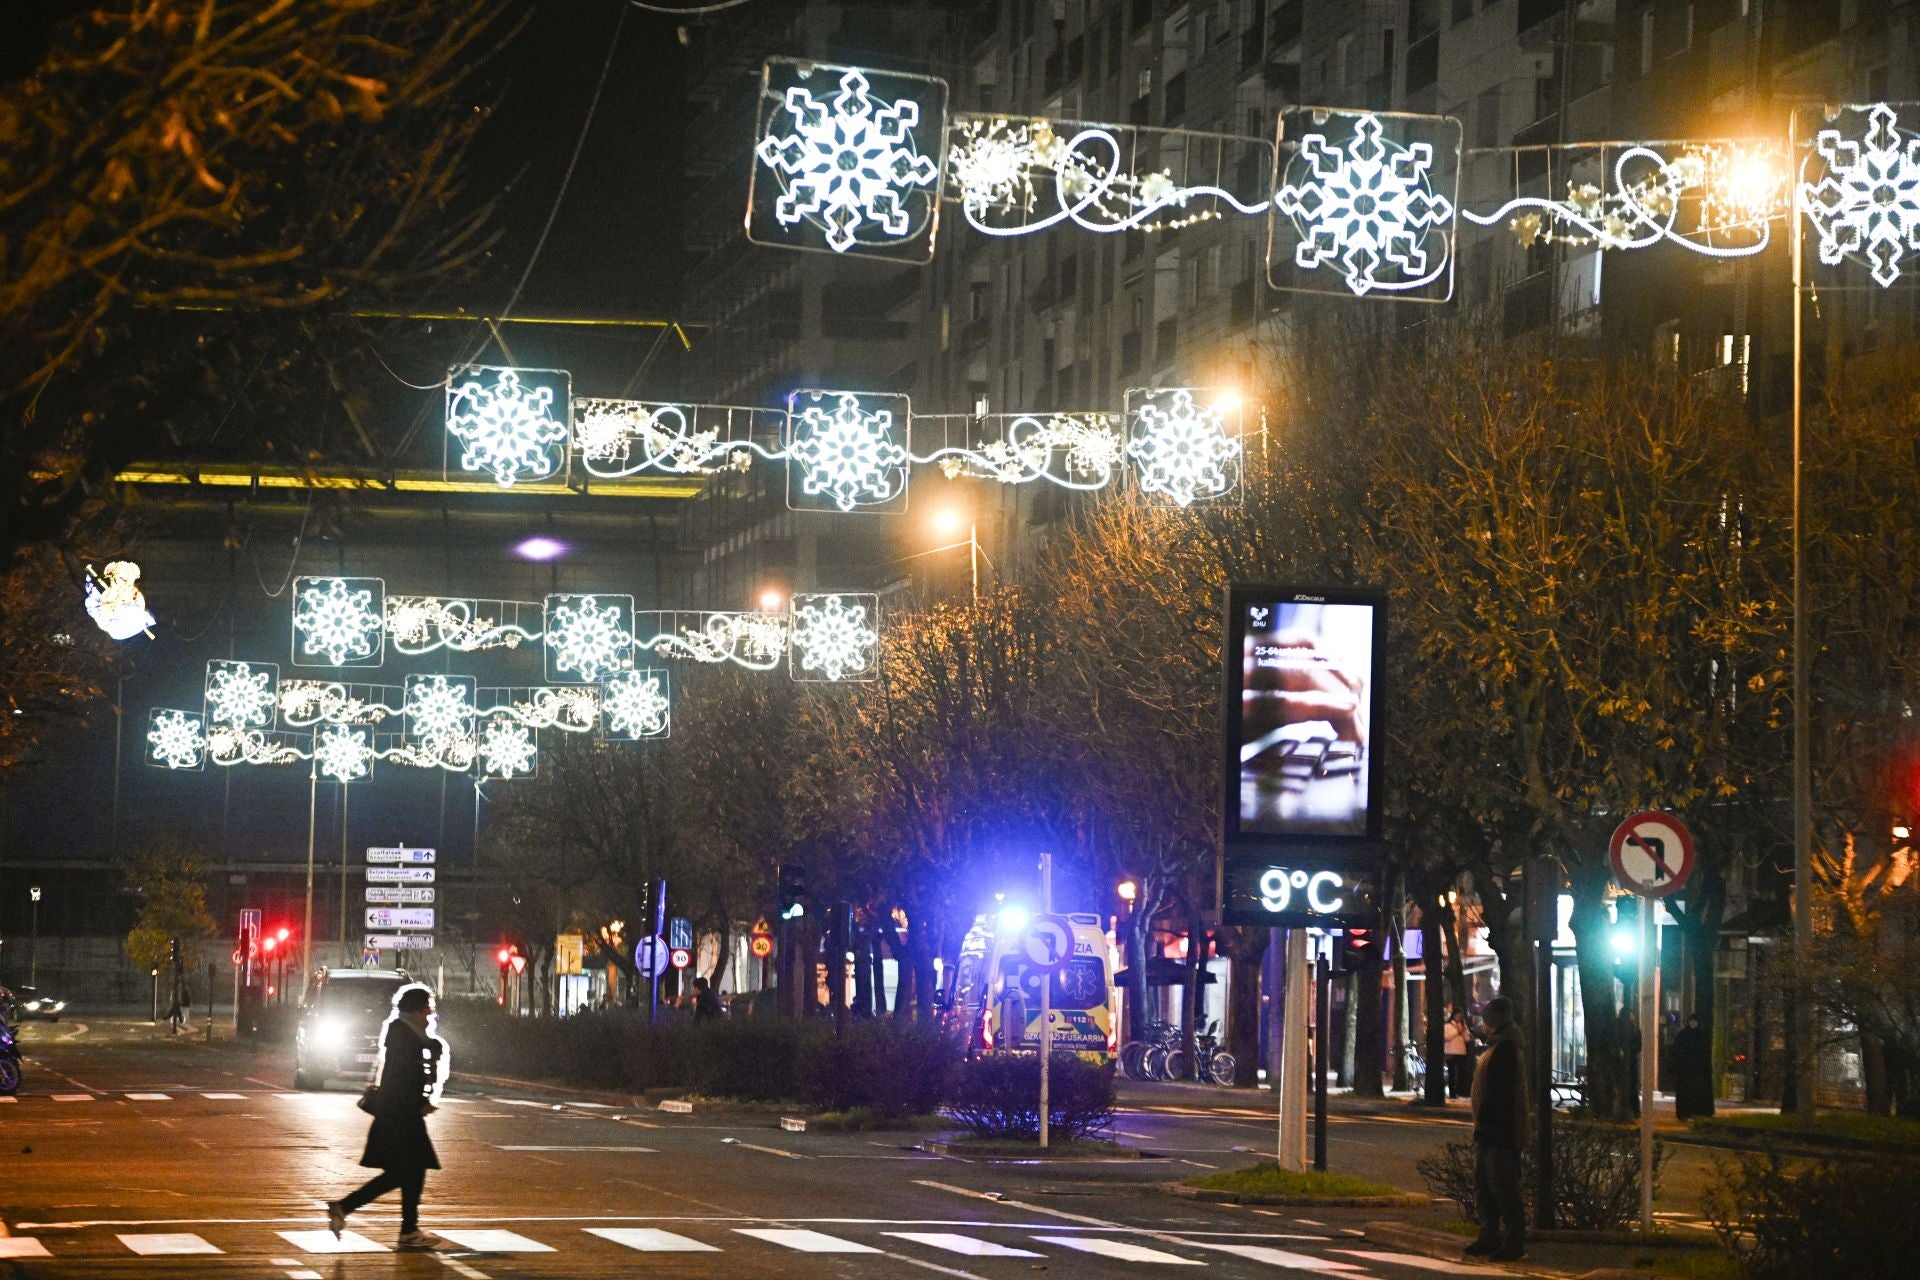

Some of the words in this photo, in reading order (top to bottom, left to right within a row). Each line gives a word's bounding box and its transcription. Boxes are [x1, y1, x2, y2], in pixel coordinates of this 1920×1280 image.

[1294, 594, 1325, 602] JCDecaux
[1260, 869, 1343, 914] 9°C
[1072, 1016, 1087, 1024] 112
